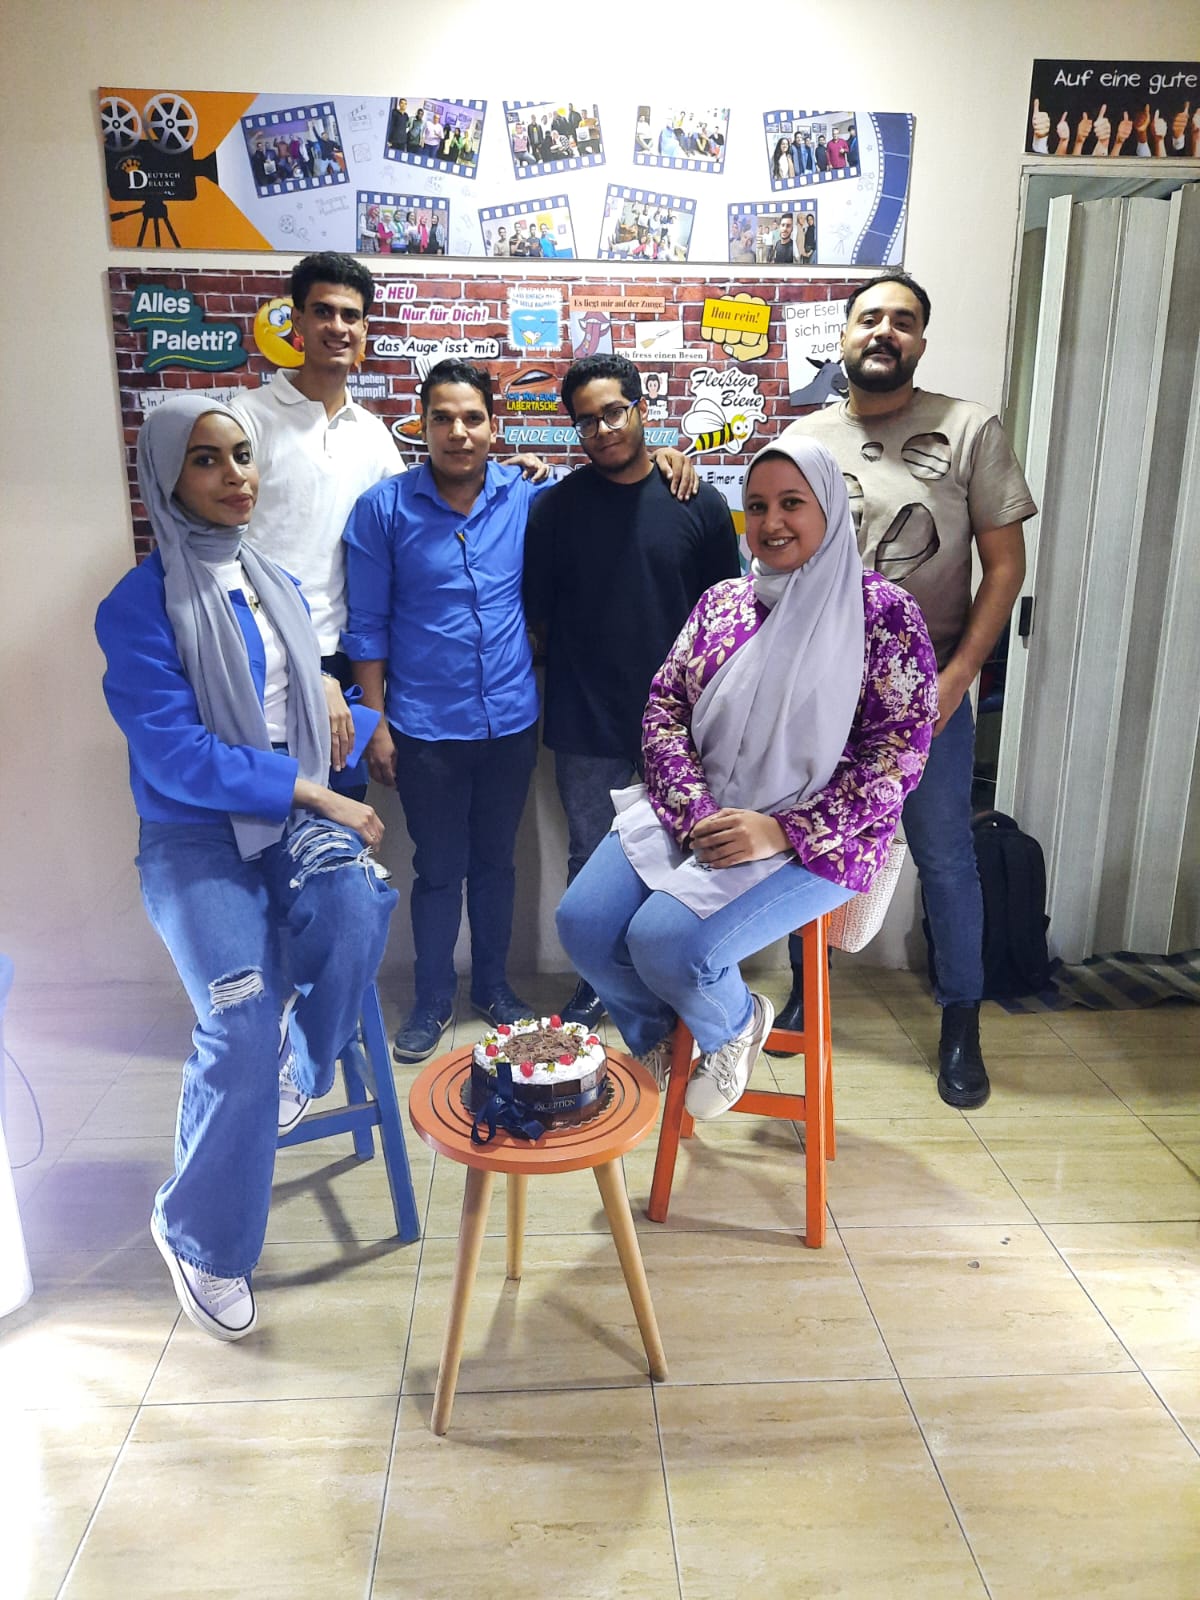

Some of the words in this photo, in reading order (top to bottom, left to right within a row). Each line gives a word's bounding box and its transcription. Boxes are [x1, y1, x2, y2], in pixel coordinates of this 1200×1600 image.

[1054, 69, 1093, 87] Auf
[1100, 70, 1141, 87] eine
[1149, 71, 1197, 94] gute
[375, 288, 383, 299] e
[388, 286, 415, 300] HEU
[136, 292, 191, 314] Alles
[584, 299, 599, 308] liegt
[600, 299, 613, 308] mir
[614, 299, 627, 308] auf
[627, 299, 640, 308] der
[402, 307, 425, 321] Nur
[429, 306, 448, 321] für
[452, 308, 487, 322] Dich!
[711, 306, 731, 320] Hau
[734, 311, 760, 324] rein!
[786, 307, 810, 320] Der
[814, 303, 839, 317] Esel
[795, 324, 820, 338] sich
[152, 330, 238, 352] Paletti?
[377, 340, 399, 353] das
[407, 340, 438, 356] Auge
[445, 341, 469, 353] isst
[474, 341, 496, 354] mit
[811, 342, 840, 354] zuer
[632, 351, 652, 359] fress
[654, 351, 677, 359] einen
[679, 351, 704, 359] Besen
[347, 375, 358, 384] en
[360, 374, 386, 385] gehen
[693, 370, 756, 393] Fleißige
[507, 401, 559, 411] LABERTASCHE
[721, 390, 762, 407] Biene
[508, 430, 550, 442] ENDE
